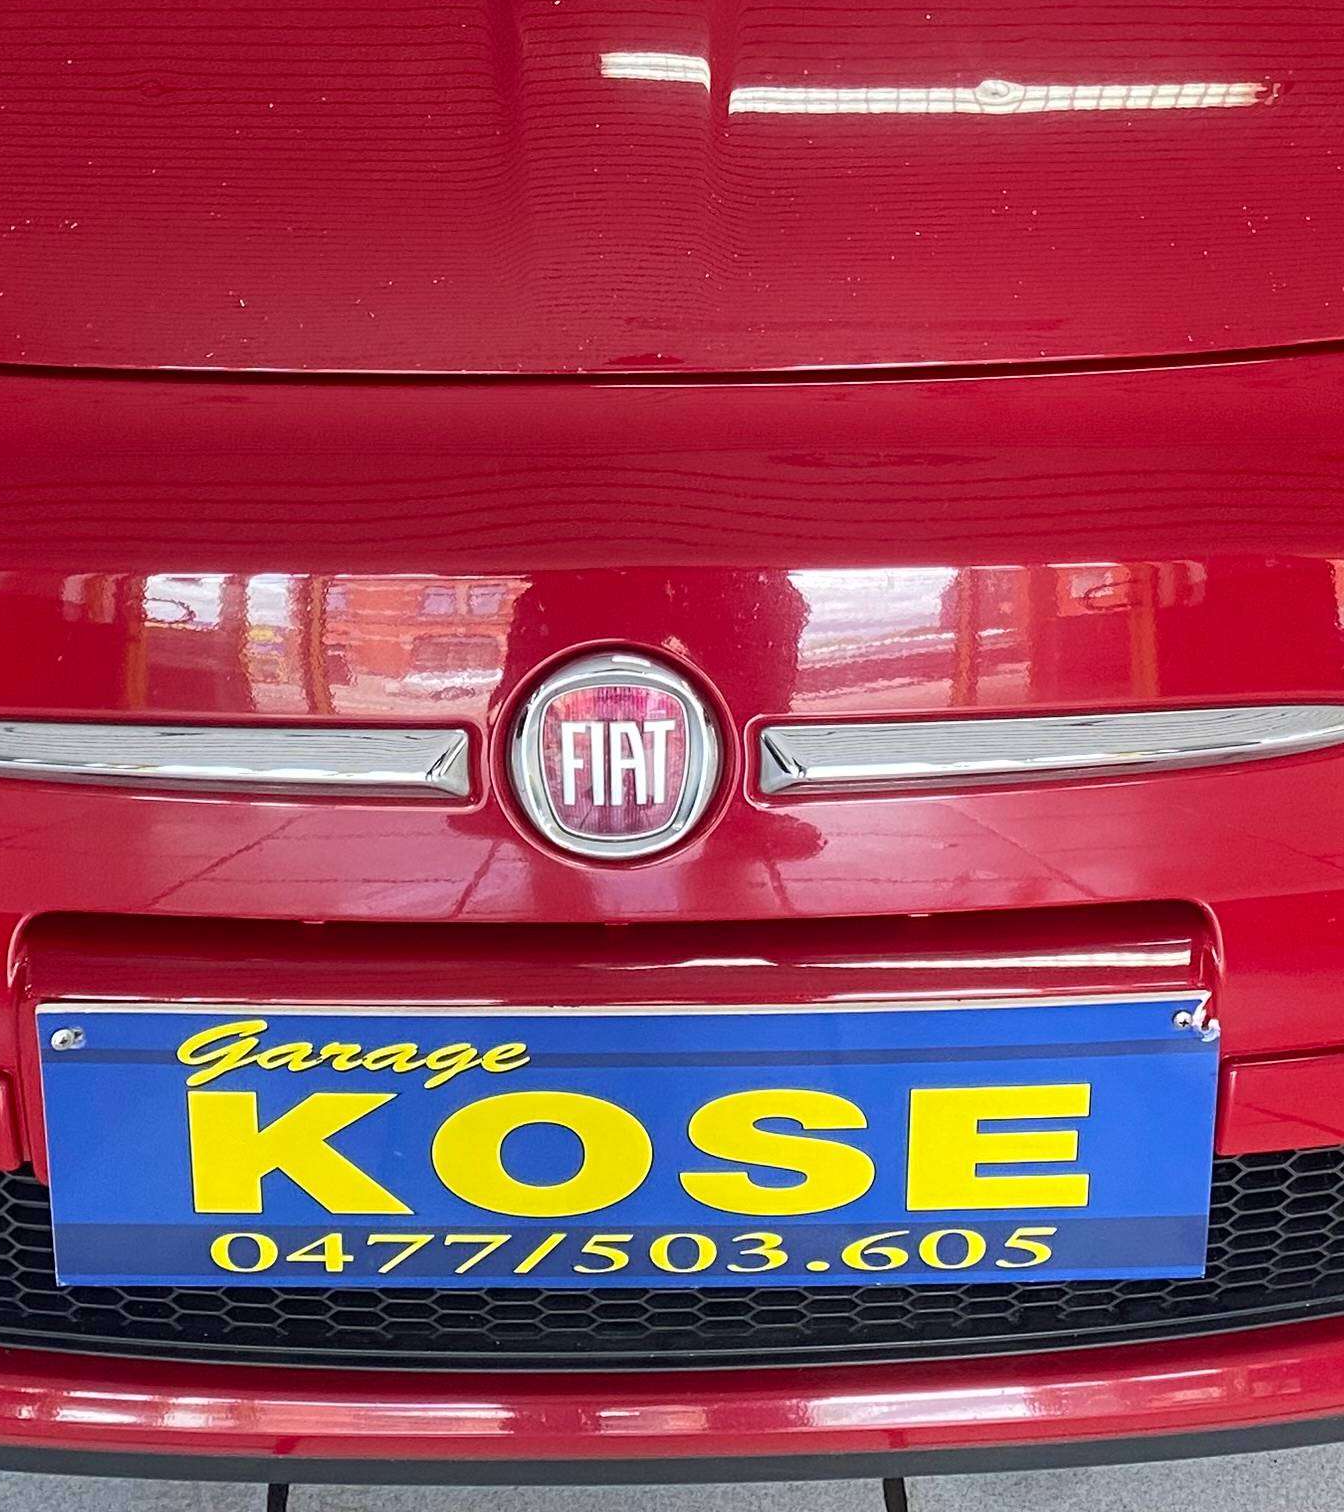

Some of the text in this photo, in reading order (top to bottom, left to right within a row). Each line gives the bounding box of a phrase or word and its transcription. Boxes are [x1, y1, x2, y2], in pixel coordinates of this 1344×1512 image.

[560, 719, 676, 806] FIAT
[176, 1019, 529, 1089] Garage
[187, 1084, 1091, 1217] KOSE
[210, 1227, 1058, 1273] 0477/503.605
